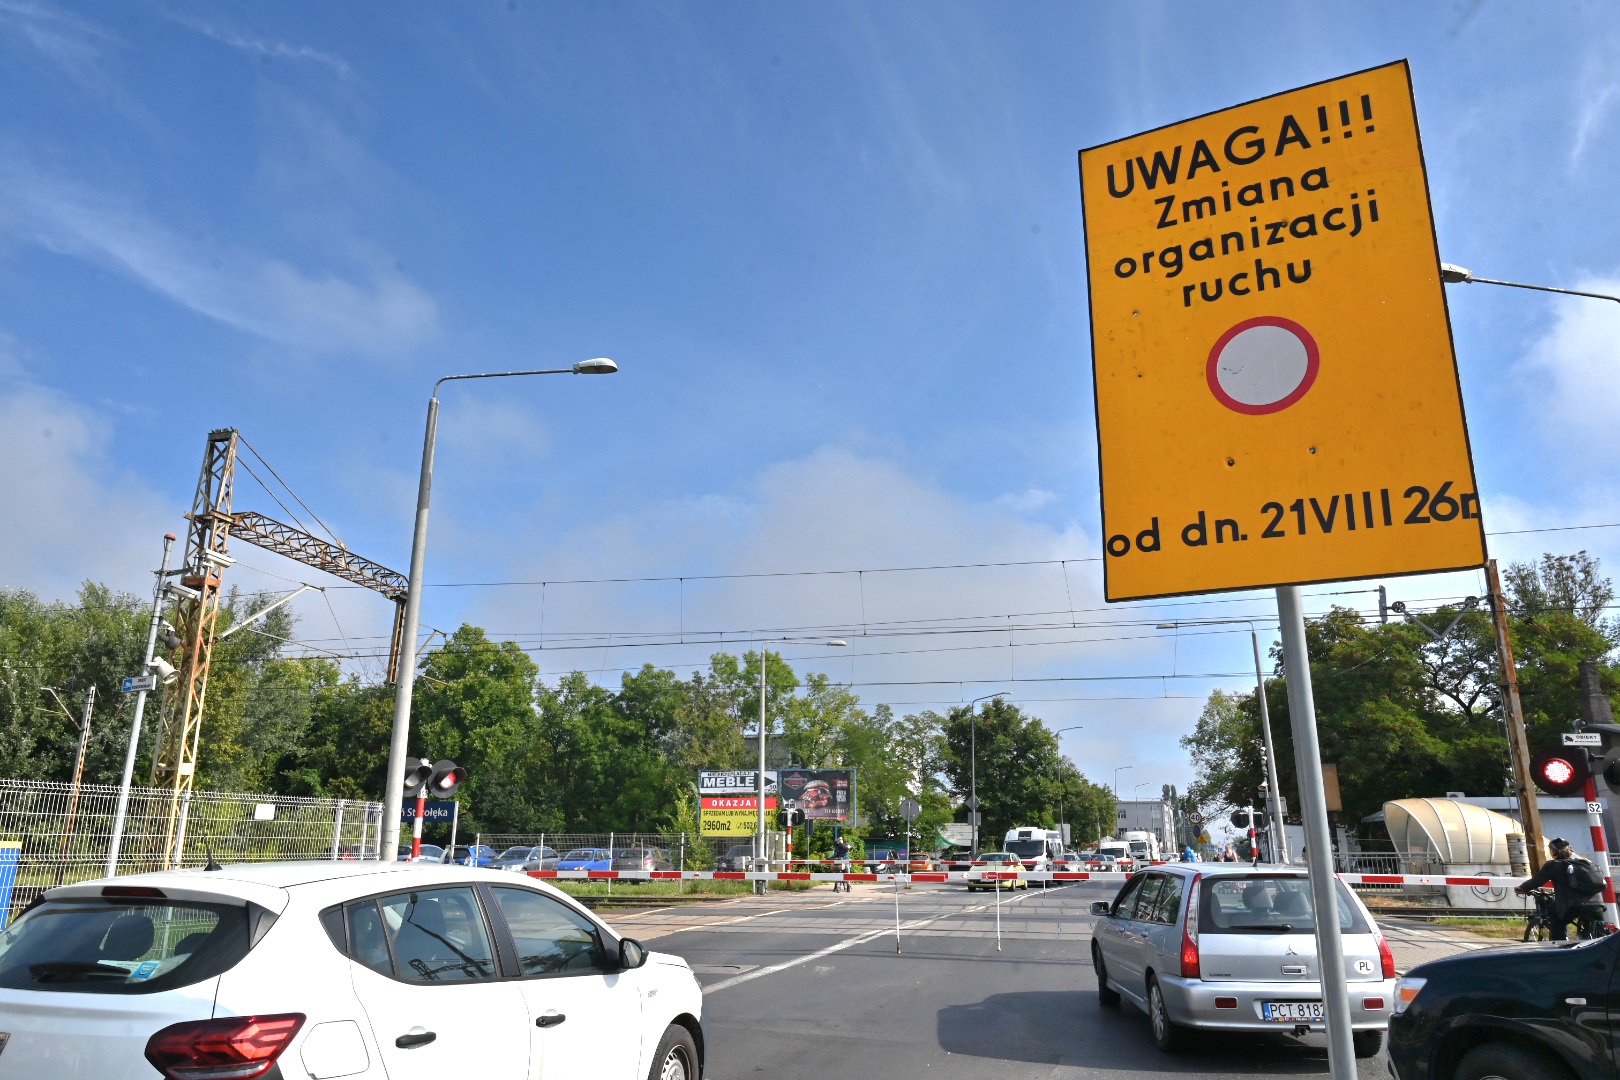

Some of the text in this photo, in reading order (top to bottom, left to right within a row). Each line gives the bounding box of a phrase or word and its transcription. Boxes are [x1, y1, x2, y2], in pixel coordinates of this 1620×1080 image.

[1106, 94, 1376, 199] UWAGA!!!
[1154, 166, 1330, 230] Zmiana
[1113, 189, 1380, 279] organizacji
[1183, 258, 1312, 308] ruchu
[1106, 516, 1161, 558] od
[1180, 510, 1248, 548] dn.
[703, 776, 755, 788] MEBLE
[711, 799, 757, 807] OKAZJA!
[1588, 803, 1602, 813] S2
[406, 807, 448, 819] Stołęka
[1359, 961, 1371, 971] PL
[1269, 1003, 1293, 1017] PCT
